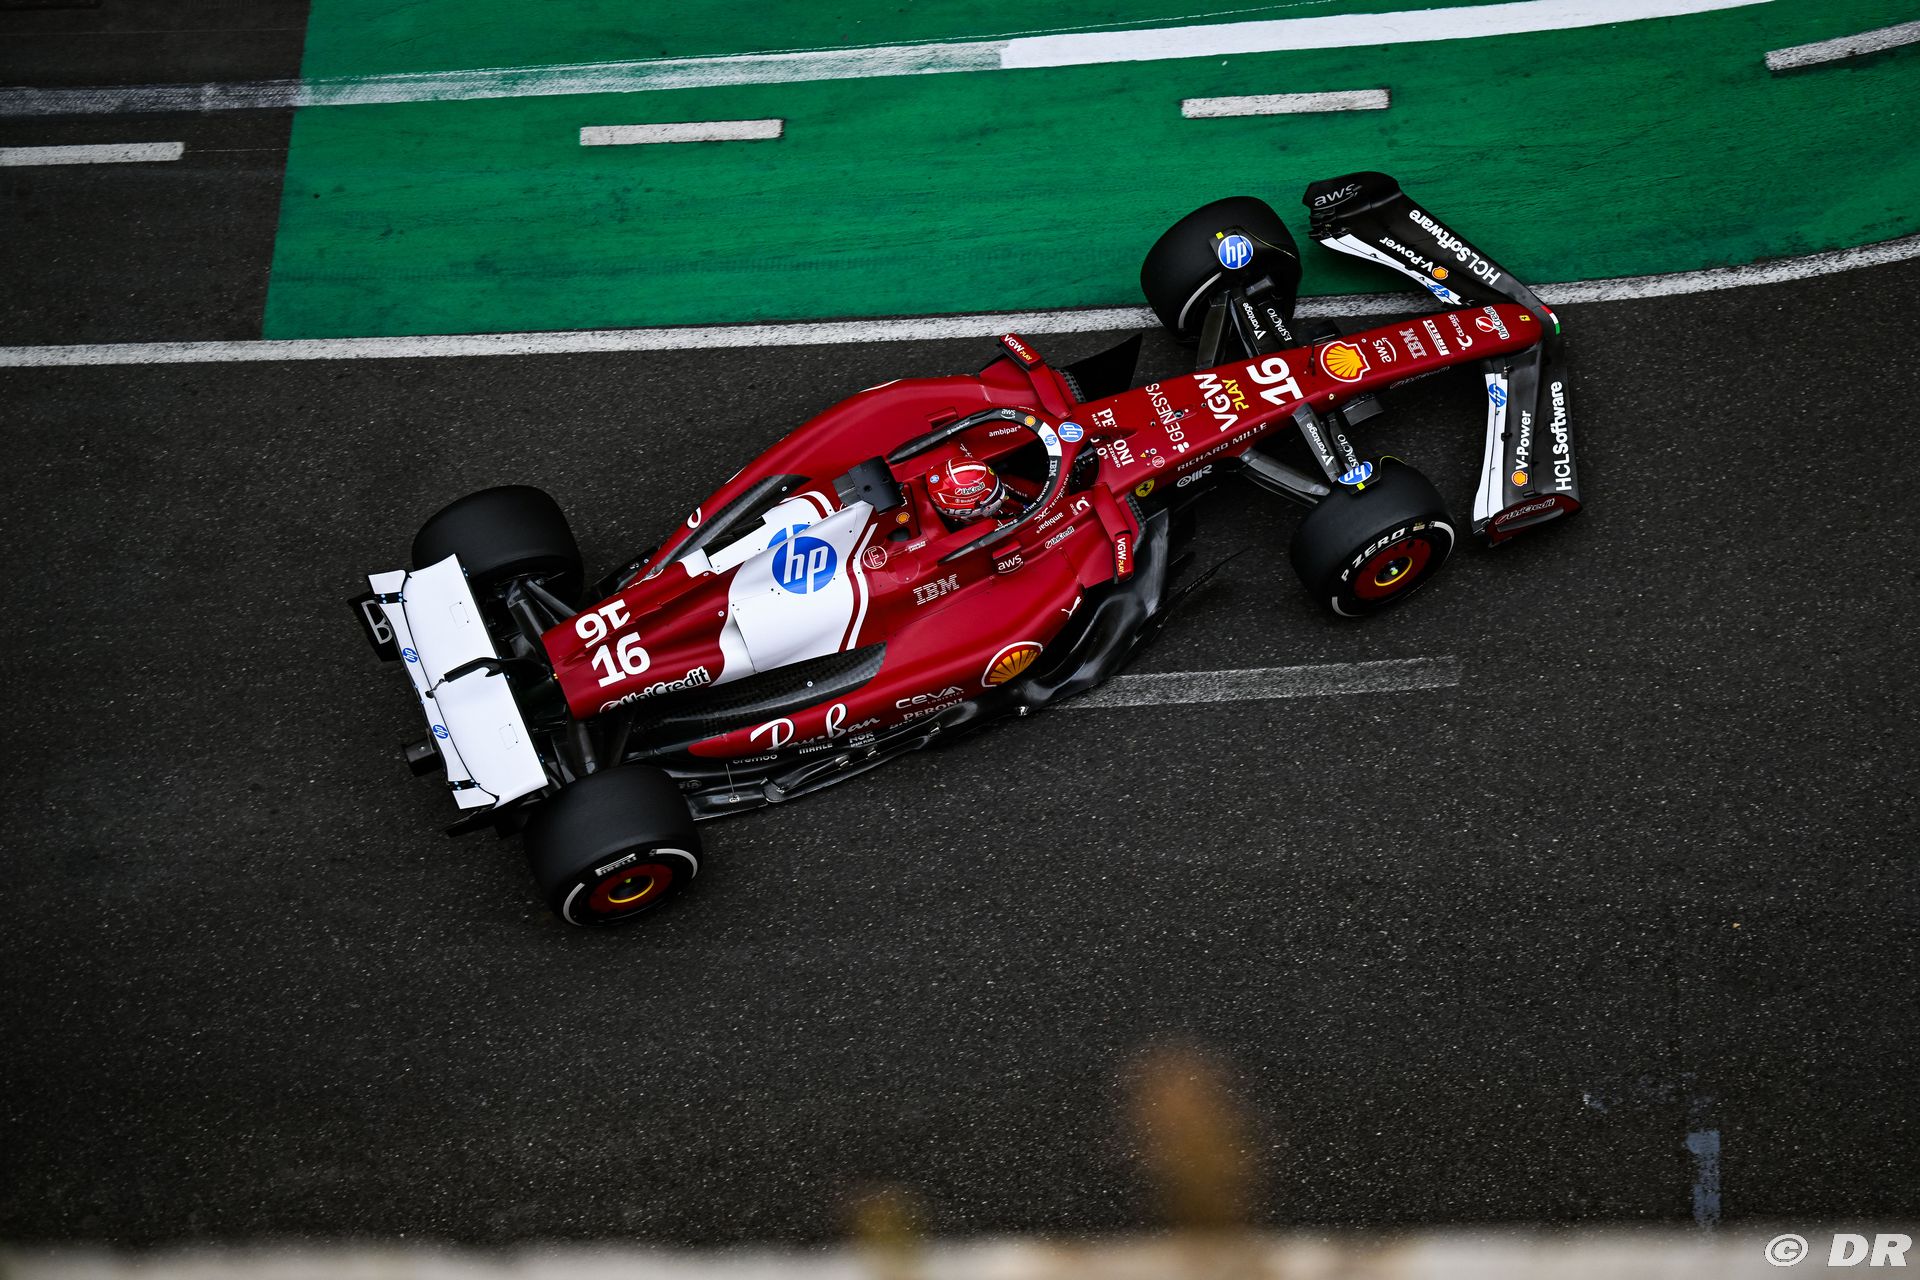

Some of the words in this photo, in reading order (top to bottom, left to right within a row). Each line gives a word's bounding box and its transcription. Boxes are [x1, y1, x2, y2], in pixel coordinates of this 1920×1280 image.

[1314, 183, 1363, 206] aws
[1224, 237, 1249, 269] hp
[1379, 235, 1434, 273] V-Power
[1408, 208, 1502, 286] HCLSoftware
[1422, 319, 1451, 356] PIRELLI
[1482, 305, 1510, 340] UniCredit
[1003, 334, 1024, 353] VGW
[1020, 350, 1033, 361] PLAY
[1371, 337, 1393, 364] aws
[1399, 328, 1427, 359] IBM
[1221, 379, 1250, 412] PLAY
[1246, 357, 1304, 406] 16
[1001, 408, 1016, 417] aws
[1145, 383, 1185, 442] GENESYS
[1193, 373, 1239, 432] VGW
[988, 426, 1019, 437] ambipar
[1060, 423, 1082, 442] hp
[1177, 443, 1229, 472] RICHARD
[1232, 422, 1268, 445] MILLE
[1515, 410, 1532, 470] V-Power
[1550, 381, 1573, 491] HCLSoftware
[1337, 434, 1359, 468] SPACIO
[1049, 459, 1058, 477] IBM
[1342, 462, 1369, 484] hp
[997, 554, 1024, 571] aws
[1117, 537, 1127, 561] VGW
[1341, 568, 1350, 582] P
[1352, 527, 1406, 569] ZERO
[778, 538, 833, 594] hp
[913, 573, 960, 606] IBM
[575, 599, 631, 649] 16
[591, 631, 651, 688] 16
[895, 686, 964, 709] CEVA
